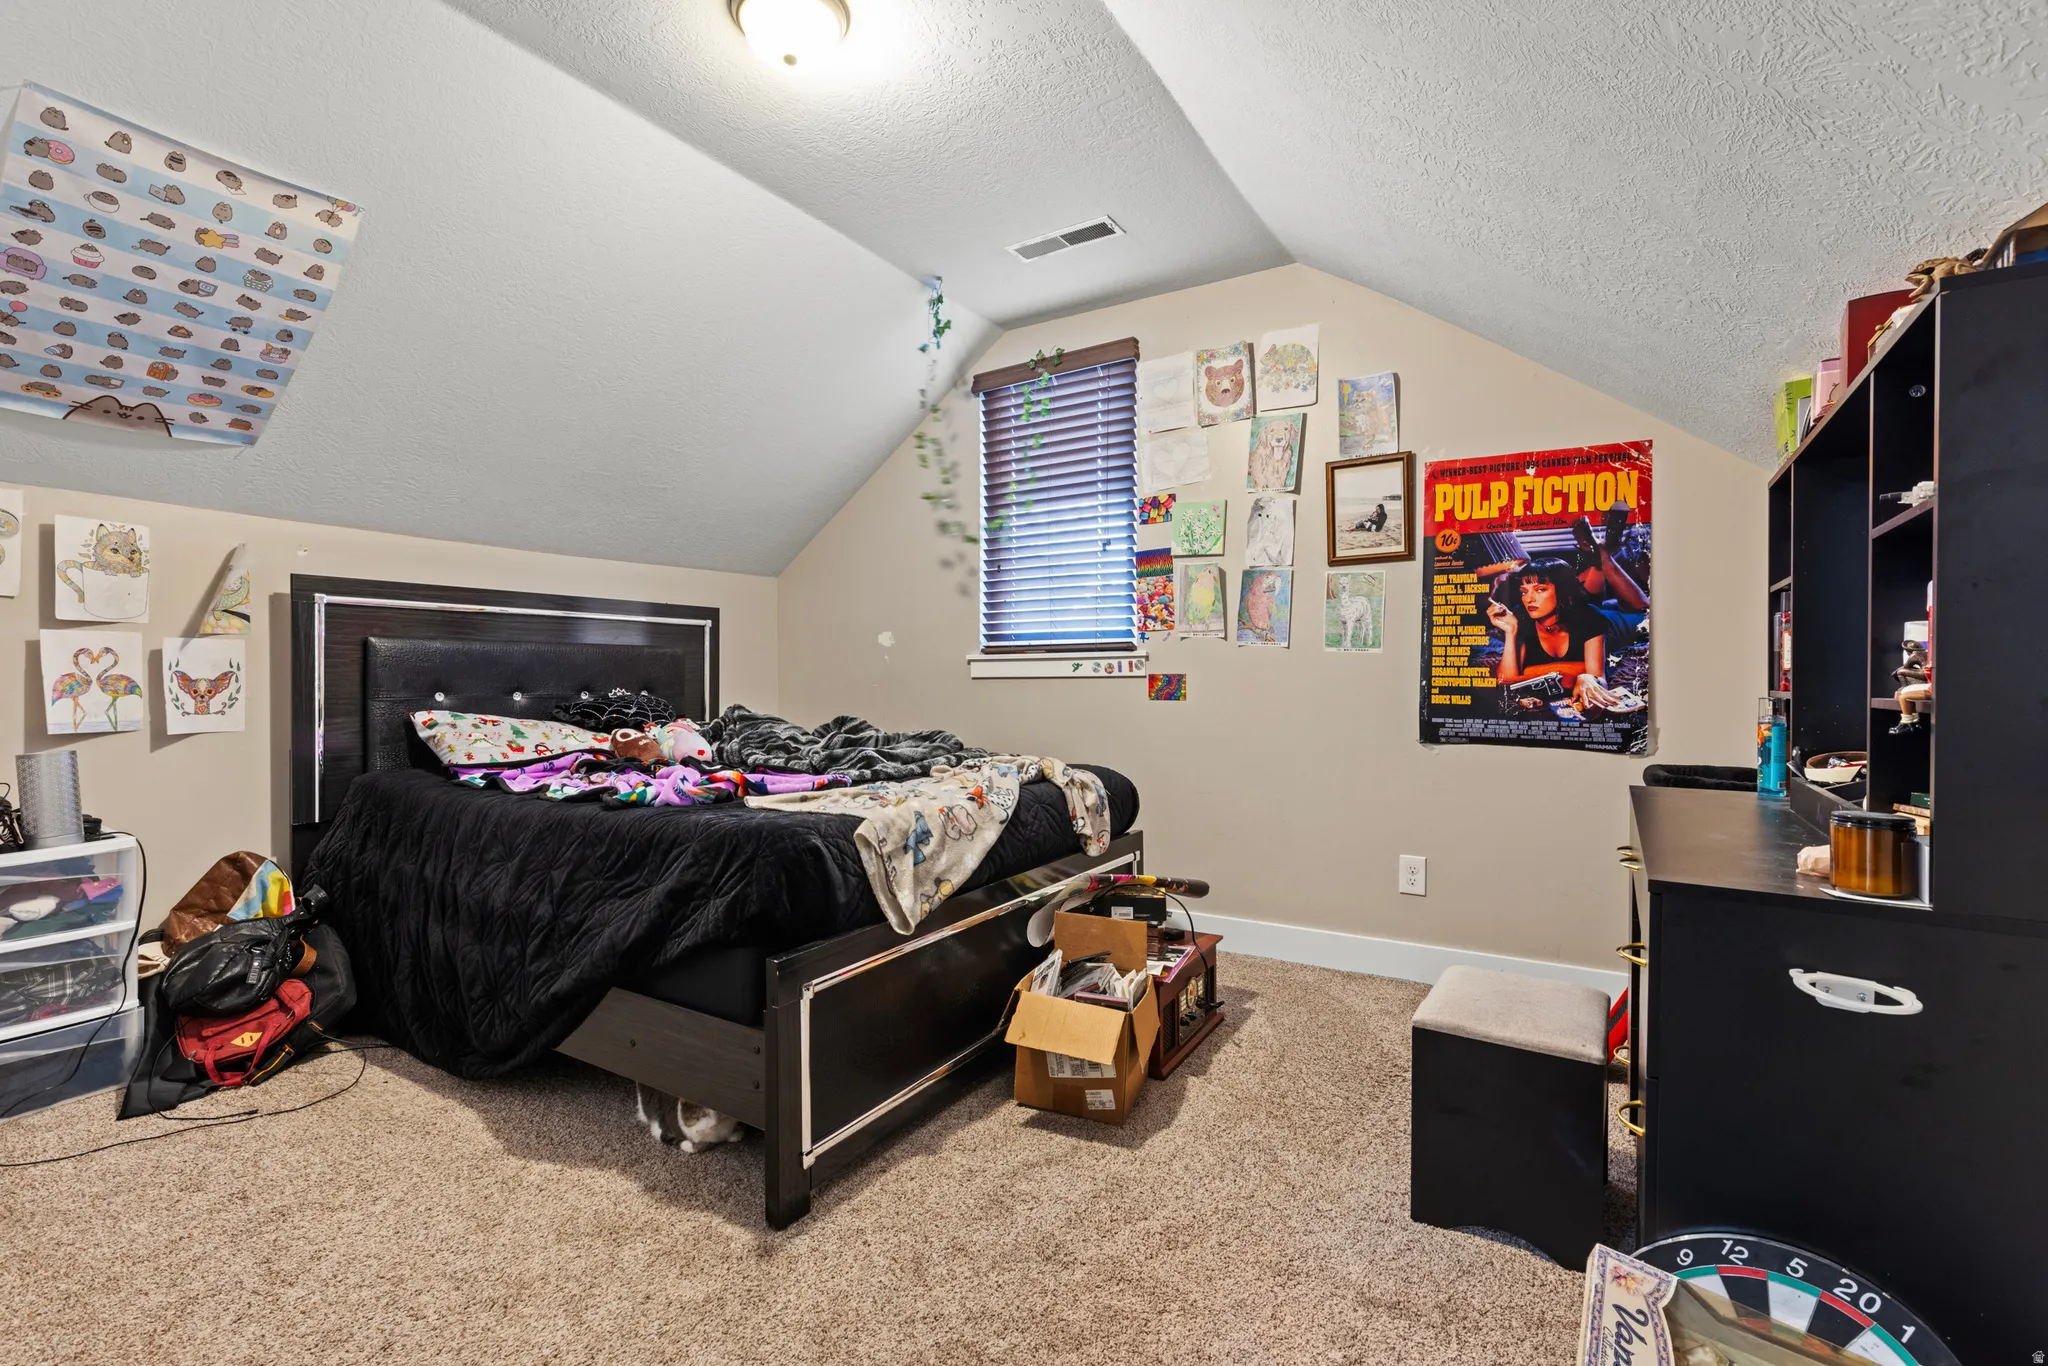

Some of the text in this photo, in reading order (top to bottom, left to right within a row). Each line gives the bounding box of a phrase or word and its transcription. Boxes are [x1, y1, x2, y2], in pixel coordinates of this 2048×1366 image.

[1489, 462, 1519, 472] PICTURE
[1542, 457, 1571, 468] CANNES
[1573, 454, 1591, 465] FILM
[1594, 452, 1631, 464] FESTIVAL
[1434, 469, 1639, 522] PULP FICTION
[1516, 519, 1550, 528] Tarantino
[1552, 517, 1567, 526] film
[1449, 573, 1477, 583] TRAVOLTA
[1433, 585, 1456, 594] SAMUEL
[1464, 584, 1490, 593] JACKSON
[1433, 594, 1475, 605] UMA THURMAN
[1433, 605, 1477, 615] HARVEY KEITEL
[1433, 615, 1461, 625] TIM ROTH
[1432, 625, 1486, 635] AMANDA PLUMMER
[1432, 636, 1450, 646] MARIA
[1460, 636, 1489, 646] MEDEIROS
[1432, 646, 1470, 656] VING RHAMES
[1432, 657, 1468, 666] ERIC STOLTZ
[1431, 667, 1490, 677] ROSANNA ARQUETTE
[1431, 677, 1497, 687] CHRISTOPHER WALKEN
[1431, 695, 1471, 705] BRUCE WILLIS
[1585, 743, 1618, 751] MIRAMAX
[1676, 1248, 1694, 1266] 9
[1721, 1239, 1749, 1266] 12
[1785, 1257, 1809, 1278] 5
[1832, 1278, 1882, 1314] 20
[1611, 1303, 1650, 1366] Van
[1900, 1324, 1916, 1344] 1
